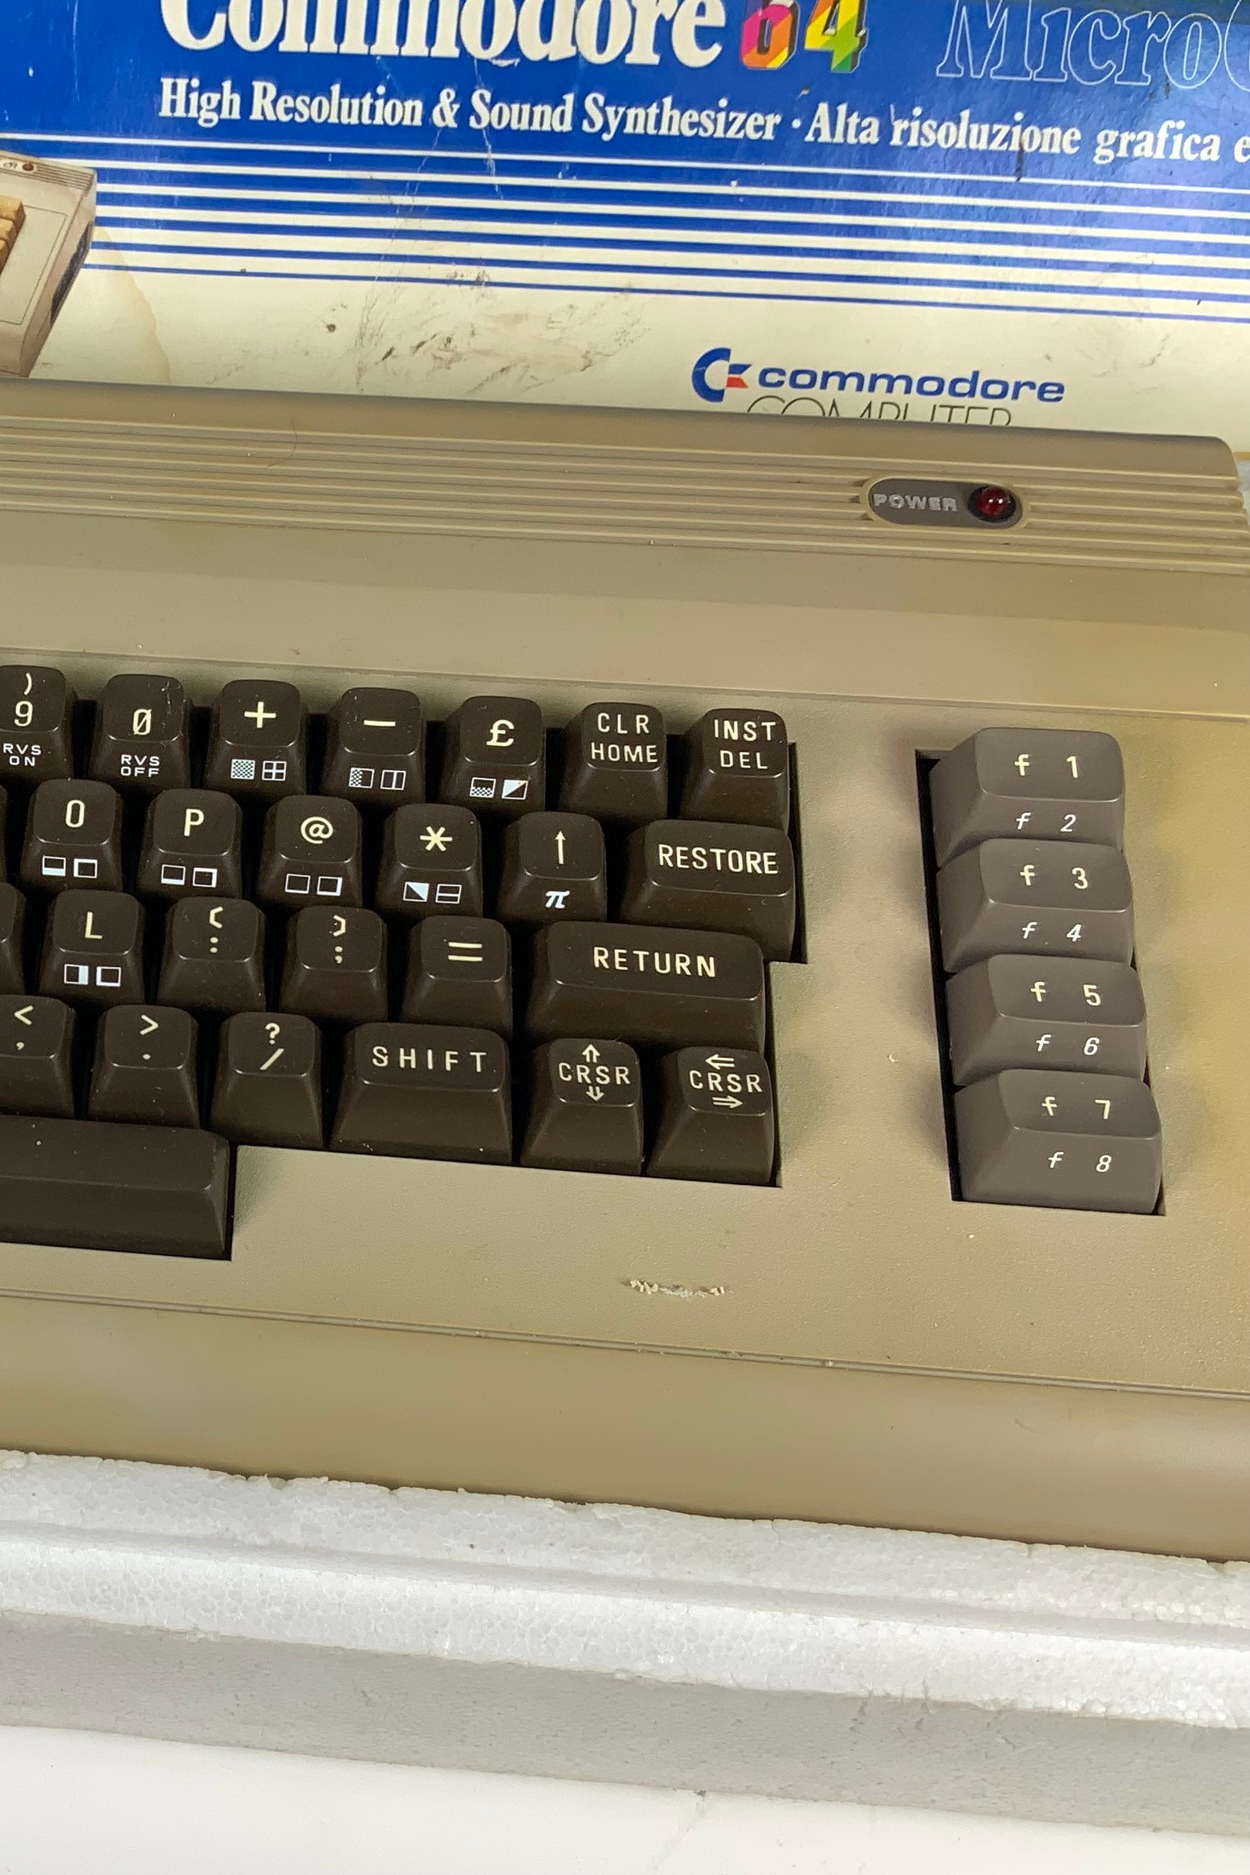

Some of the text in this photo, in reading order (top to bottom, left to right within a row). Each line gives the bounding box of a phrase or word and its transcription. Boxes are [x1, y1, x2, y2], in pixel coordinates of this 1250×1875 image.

[936, 0, 1250, 93] Micro
[159, 78, 240, 127] High
[250, 81, 423, 126] Resolution
[432, 88, 460, 127] &
[470, 89, 574, 136] Sound
[582, 93, 781, 141] Synthesizer
[805, 102, 879, 144] Alta
[889, 104, 1081, 155] risoluzione
[1093, 120, 1221, 165] grafica
[756, 364, 1067, 405] commodore
[873, 491, 959, 513] POWER
[24, 673, 32, 695] )
[14, 701, 33, 726] 9
[244, 702, 276, 728] +
[598, 713, 649, 733] CLR
[487, 720, 514, 746] £
[715, 720, 776, 741] INST
[3, 742, 41, 757] RVS
[592, 742, 657, 762] HOME
[720, 750, 767, 769] DEL
[10, 755, 38, 767] ON
[121, 755, 159, 769] RVS
[121, 764, 159, 777] OFF
[66, 800, 85, 827] O
[184, 809, 204, 836] P
[301, 817, 333, 844] @
[659, 844, 778, 874] RESTORE
[85, 912, 102, 939] L
[210, 937, 218, 952] :
[335, 946, 342, 963] ;
[448, 942, 482, 961] =
[594, 947, 715, 977] RETURN
[15, 1006, 33, 1025] <
[140, 1015, 158, 1035] >
[266, 1023, 280, 1044] ?
[260, 1049, 284, 1070] /
[373, 1046, 486, 1072] SHIFT
[559, 1060, 630, 1088] CRSR
[690, 1067, 762, 1092] CRSR
